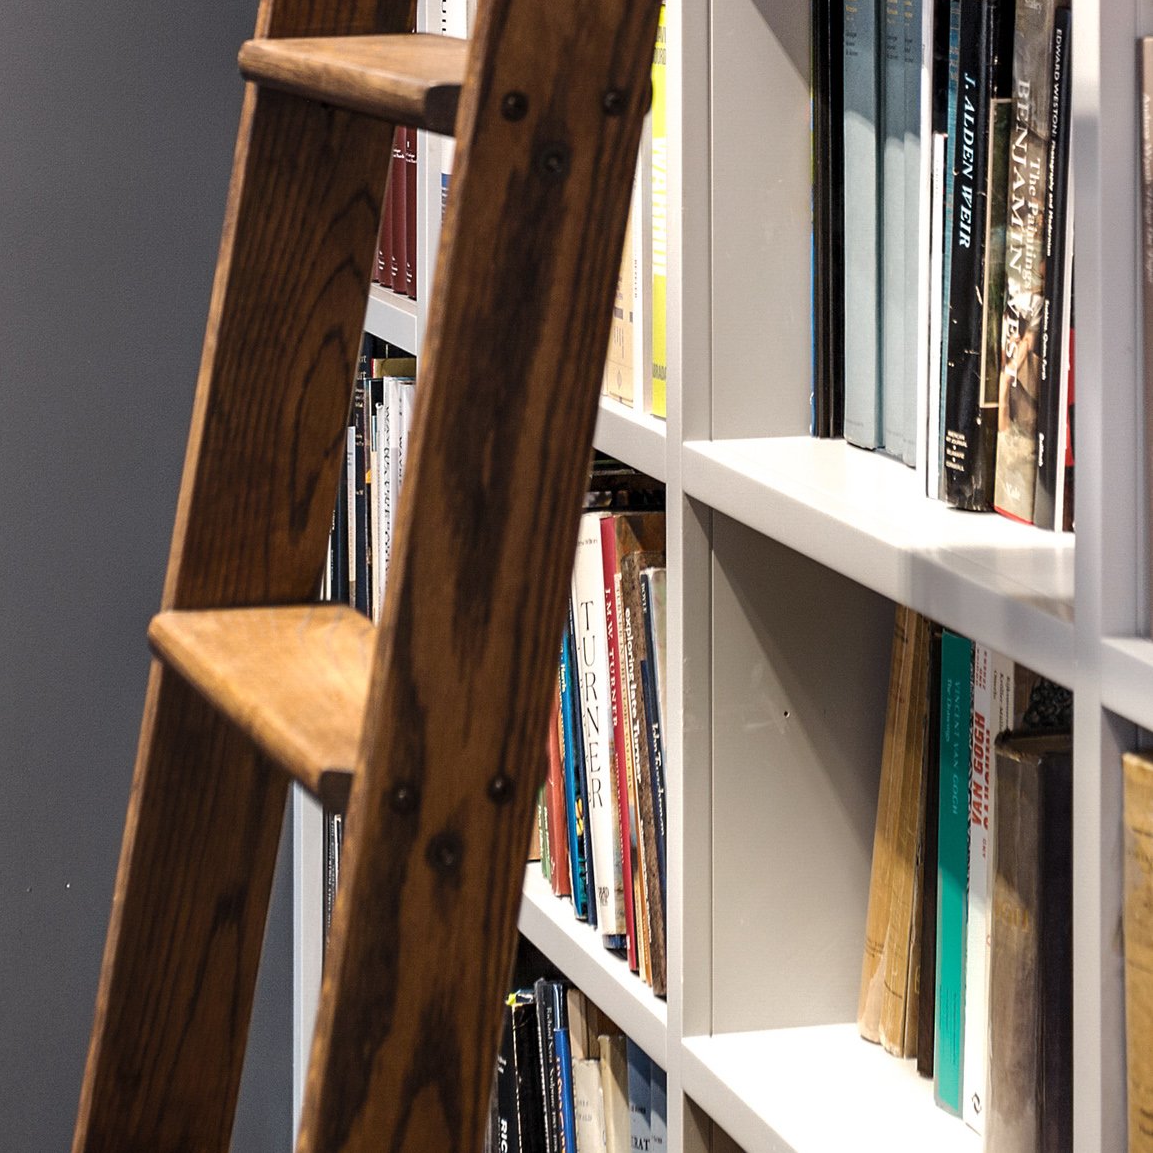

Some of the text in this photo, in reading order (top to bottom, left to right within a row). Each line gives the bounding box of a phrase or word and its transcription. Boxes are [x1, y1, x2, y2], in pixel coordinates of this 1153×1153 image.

[1053, 28, 1063, 81] EDWARD
[1051, 83, 1061, 138] WESTON:
[958, 72, 976, 249] J. ALDEN WEIR
[1028, 158, 1041, 196] The
[1047, 140, 1056, 191] Photography
[1004, 79, 1031, 387] BENJAMIN WEST
[1022, 199, 1040, 293] Paintings
[1046, 211, 1054, 257] Modernism
[580, 600, 603, 808] TURNER
[608, 648, 618, 727] TURNER
[625, 608, 642, 784] exploring late Turner
[953, 680, 961, 737] VINCENT
[951, 773, 959, 815] GOGH
[971, 711, 985, 827] VAN GOGH
[546, 1007, 554, 1040] Richard
